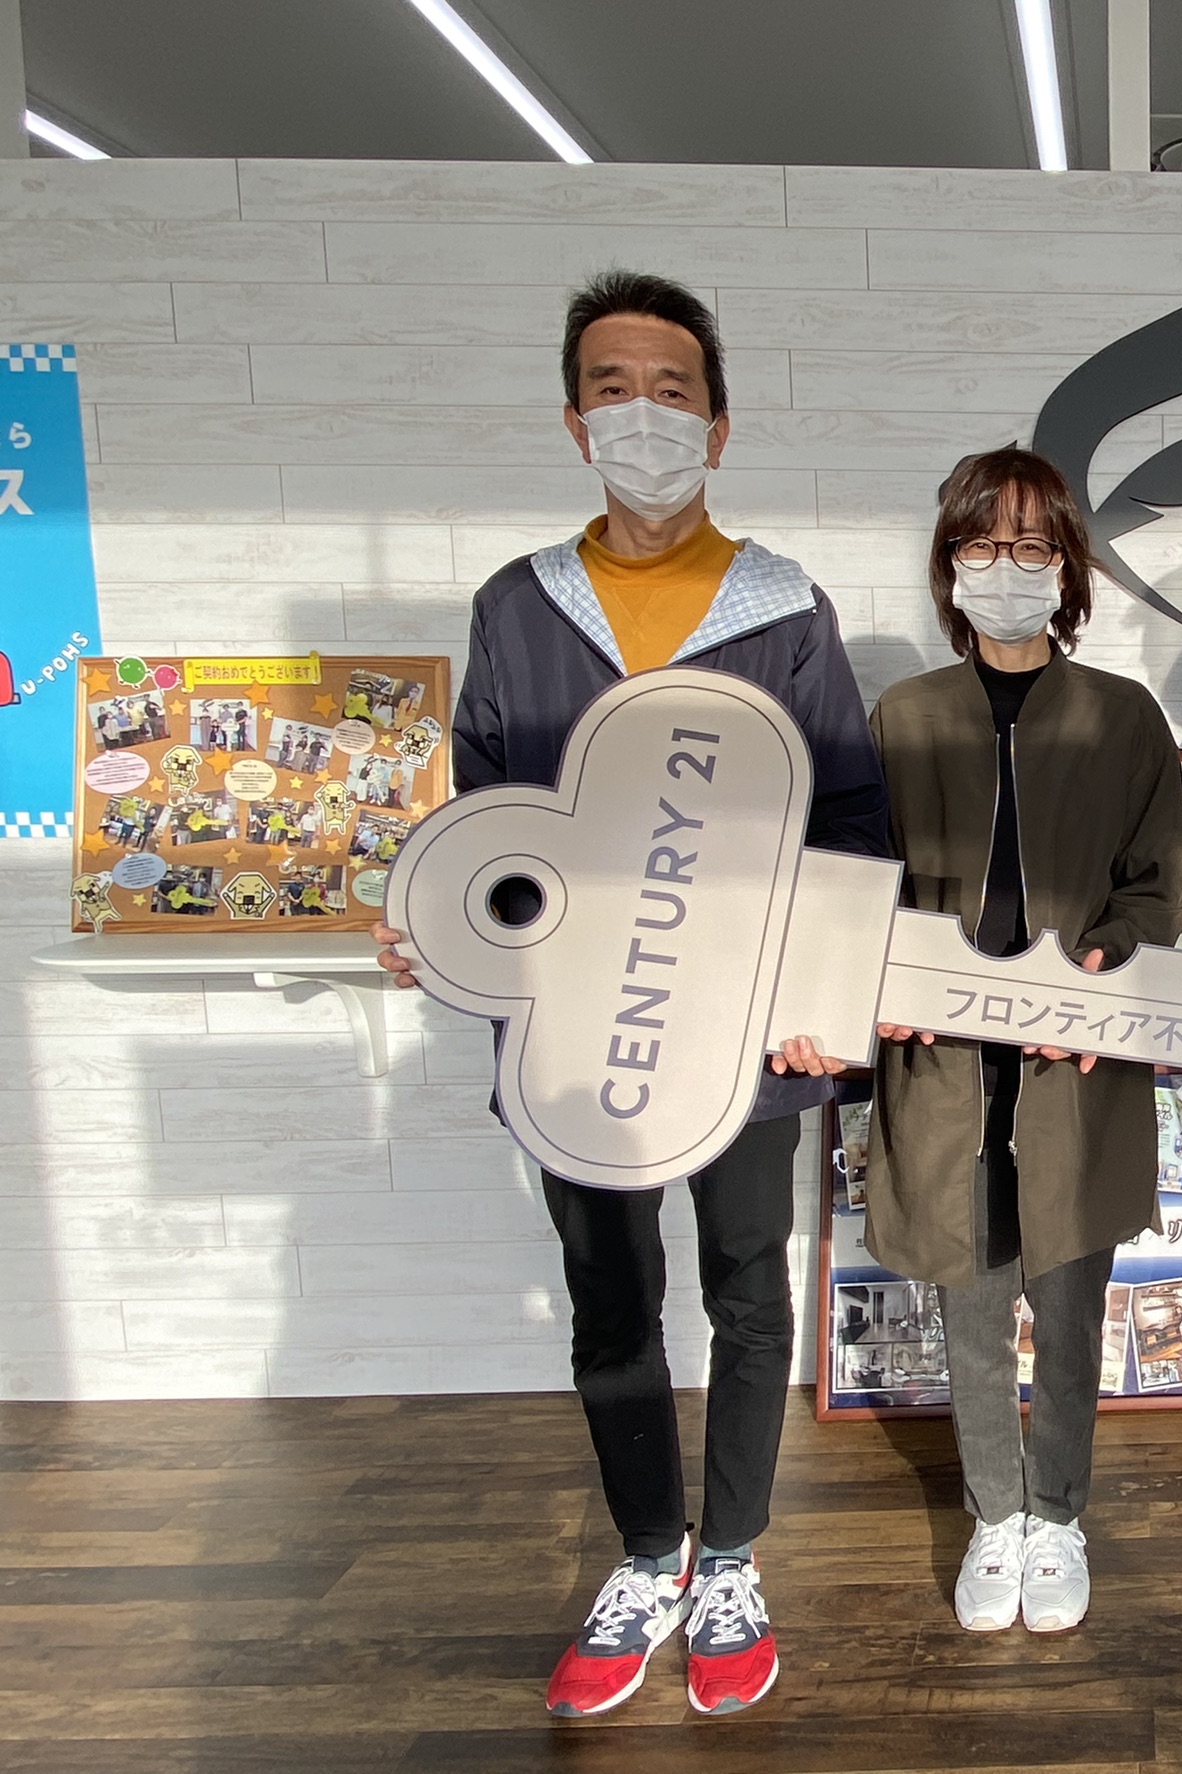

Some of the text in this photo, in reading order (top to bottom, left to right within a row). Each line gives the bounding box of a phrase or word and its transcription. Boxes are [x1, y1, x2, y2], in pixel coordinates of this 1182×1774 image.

[9, 421, 33, 449] ら
[600, 727, 721, 1119] CENTURY 21
